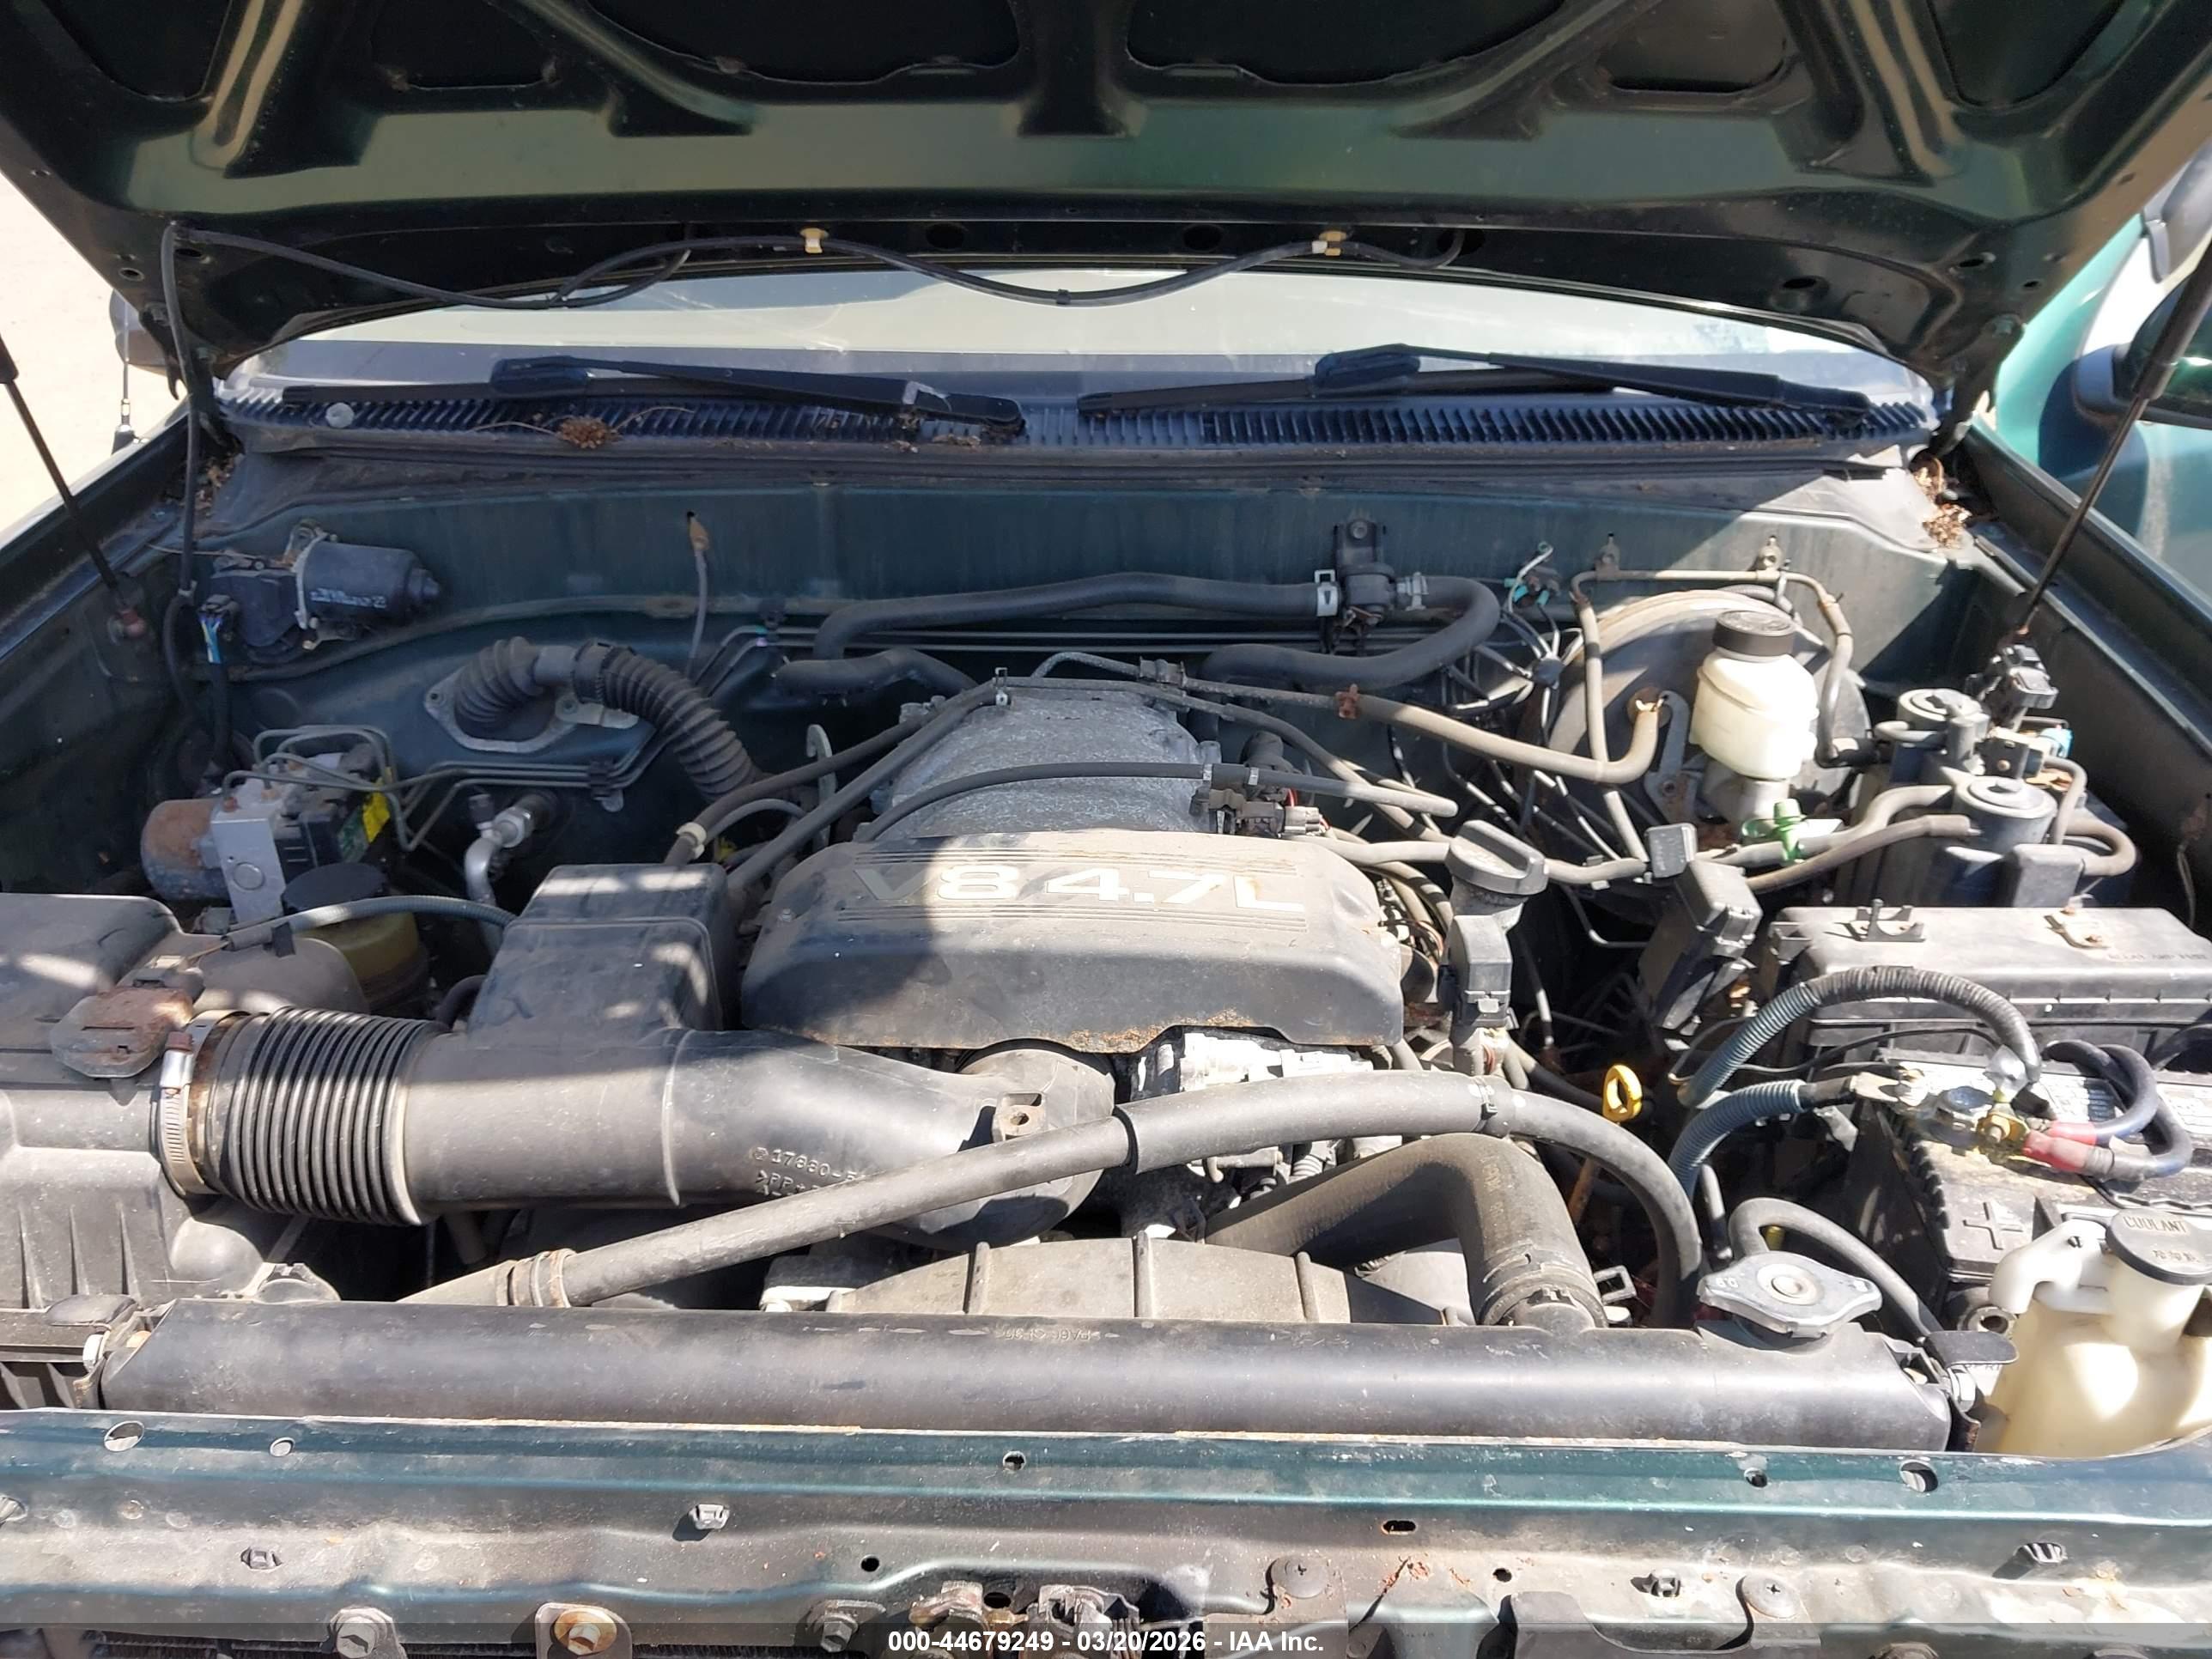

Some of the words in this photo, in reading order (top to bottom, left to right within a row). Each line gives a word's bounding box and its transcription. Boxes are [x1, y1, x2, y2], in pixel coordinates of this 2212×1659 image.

[854, 863, 1022, 902] V8
[1046, 867, 1304, 911] 4.7L
[2123, 1215, 2187, 1233] COOLANT
